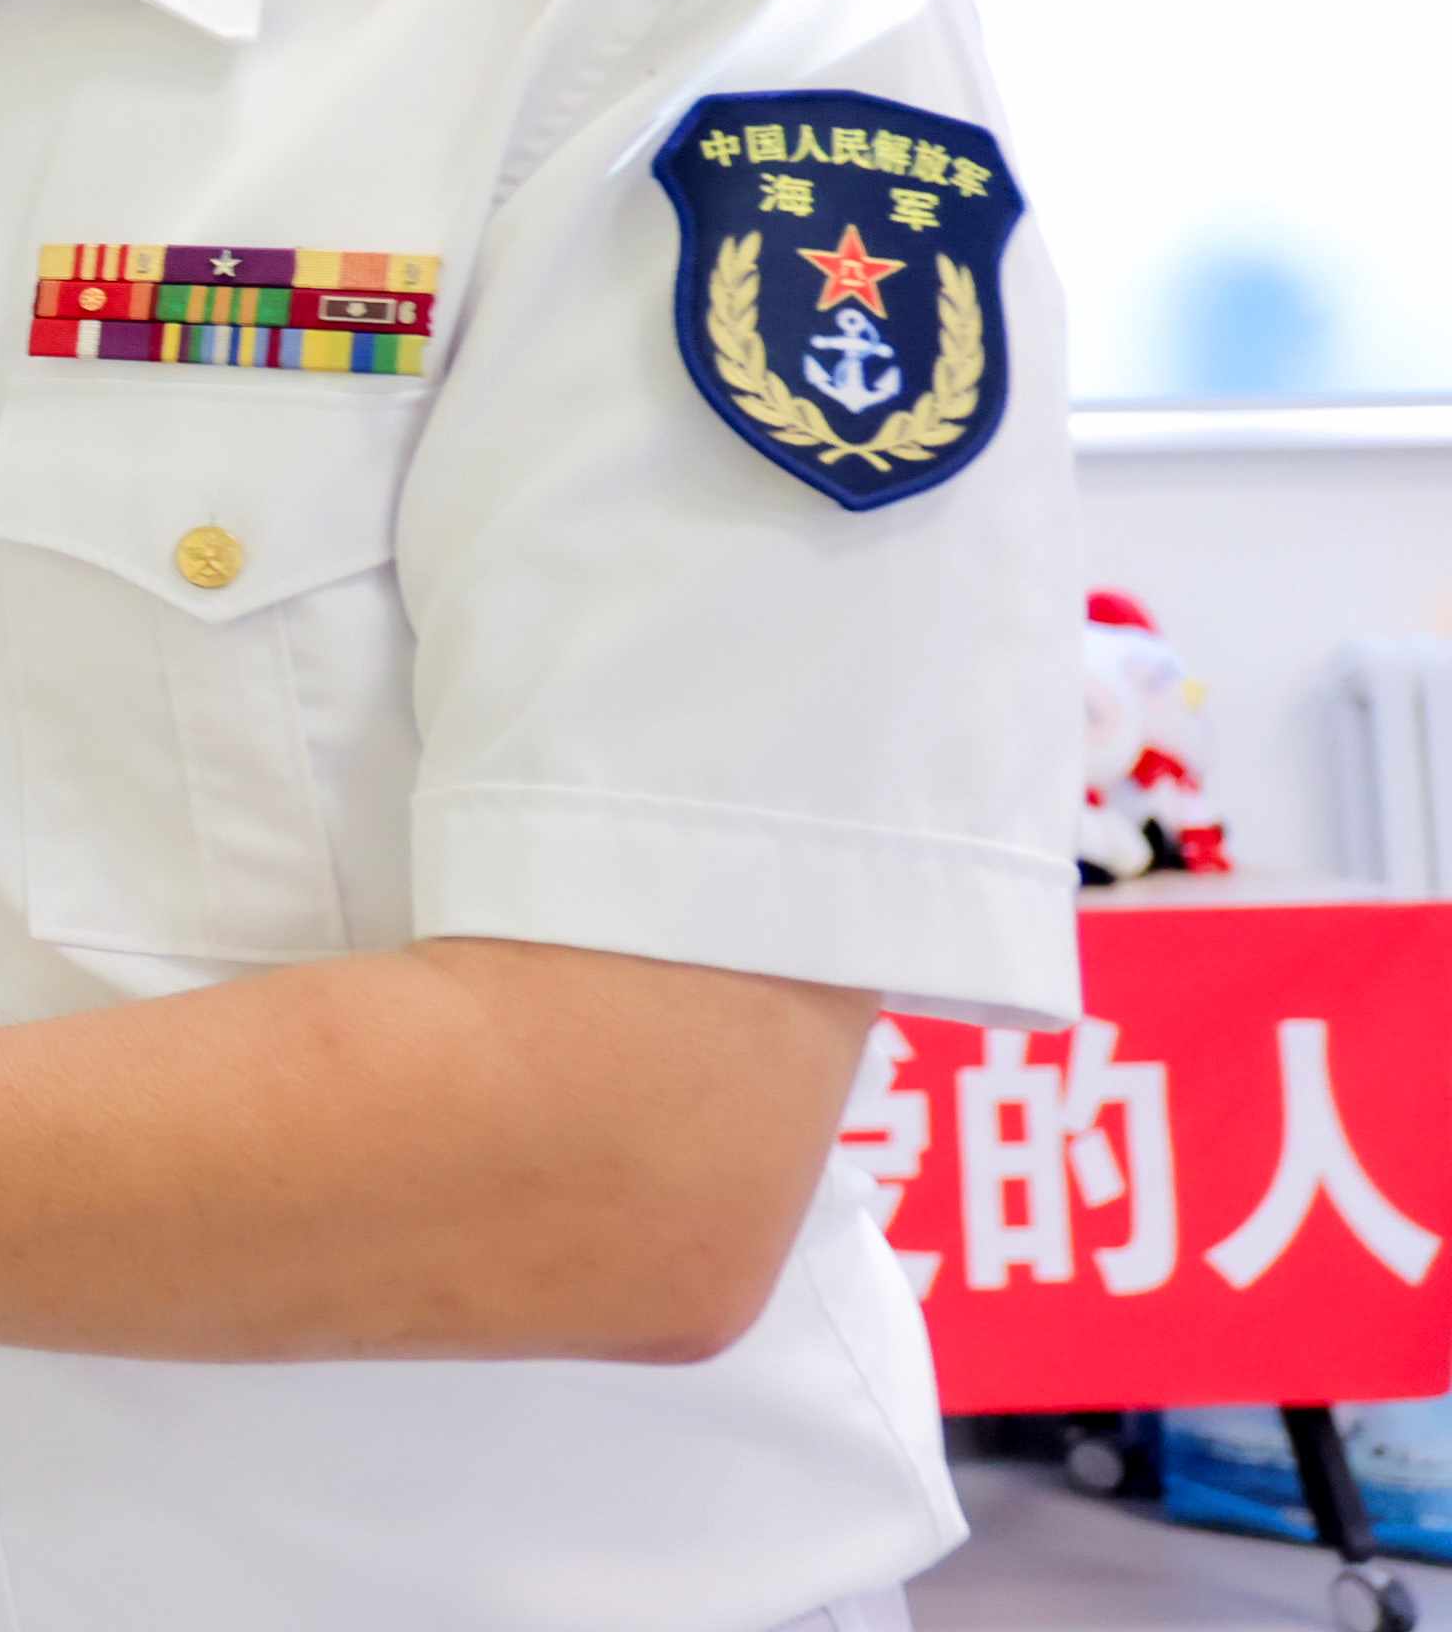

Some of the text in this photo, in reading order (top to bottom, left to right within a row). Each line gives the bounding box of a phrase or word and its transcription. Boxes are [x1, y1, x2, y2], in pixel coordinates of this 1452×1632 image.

[699, 123, 993, 199] 中国人民解放军
[758, 172, 942, 232] 海军
